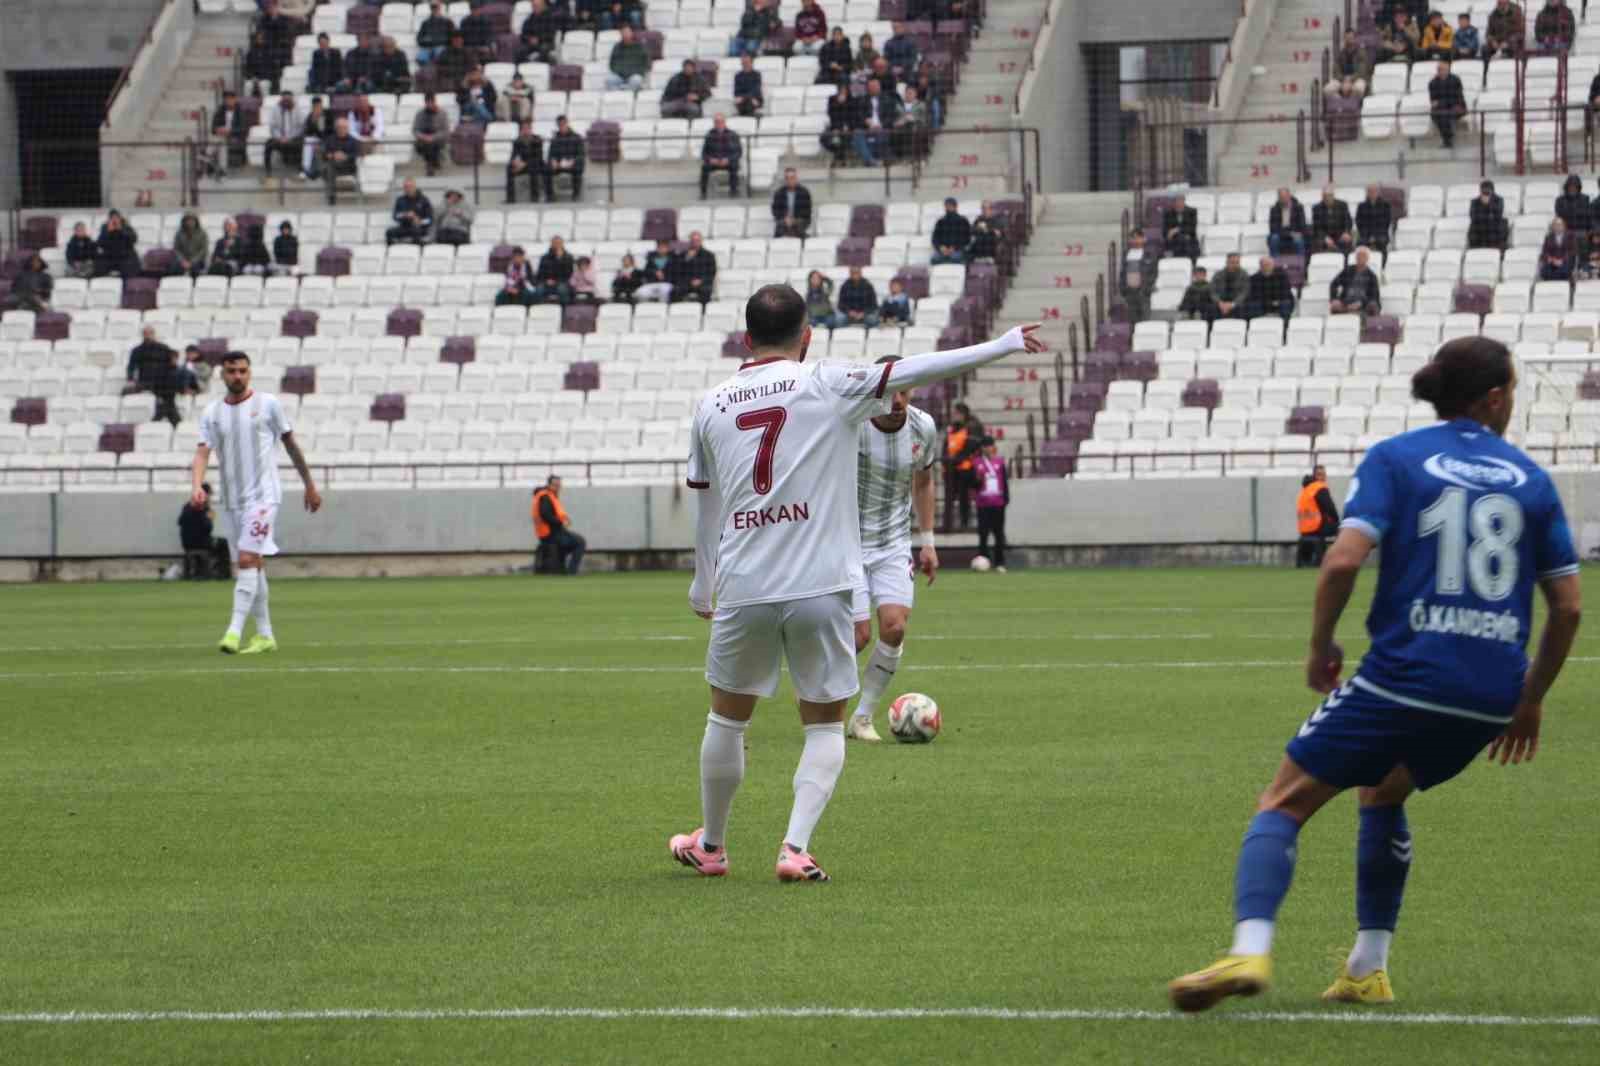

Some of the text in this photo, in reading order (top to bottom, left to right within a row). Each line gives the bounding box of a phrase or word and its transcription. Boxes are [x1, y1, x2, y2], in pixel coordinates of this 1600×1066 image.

[1259, 144, 1279, 155] 20
[960, 154, 978, 166] 20
[1251, 166, 1271, 177] 21
[951, 176, 968, 188] 21
[1016, 368, 1038, 382] 26
[1004, 397, 1024, 410] 27
[736, 406, 787, 495] 7
[734, 502, 809, 529] ERKAN
[250, 521, 269, 538] 34
[1418, 486, 1524, 602] 18
